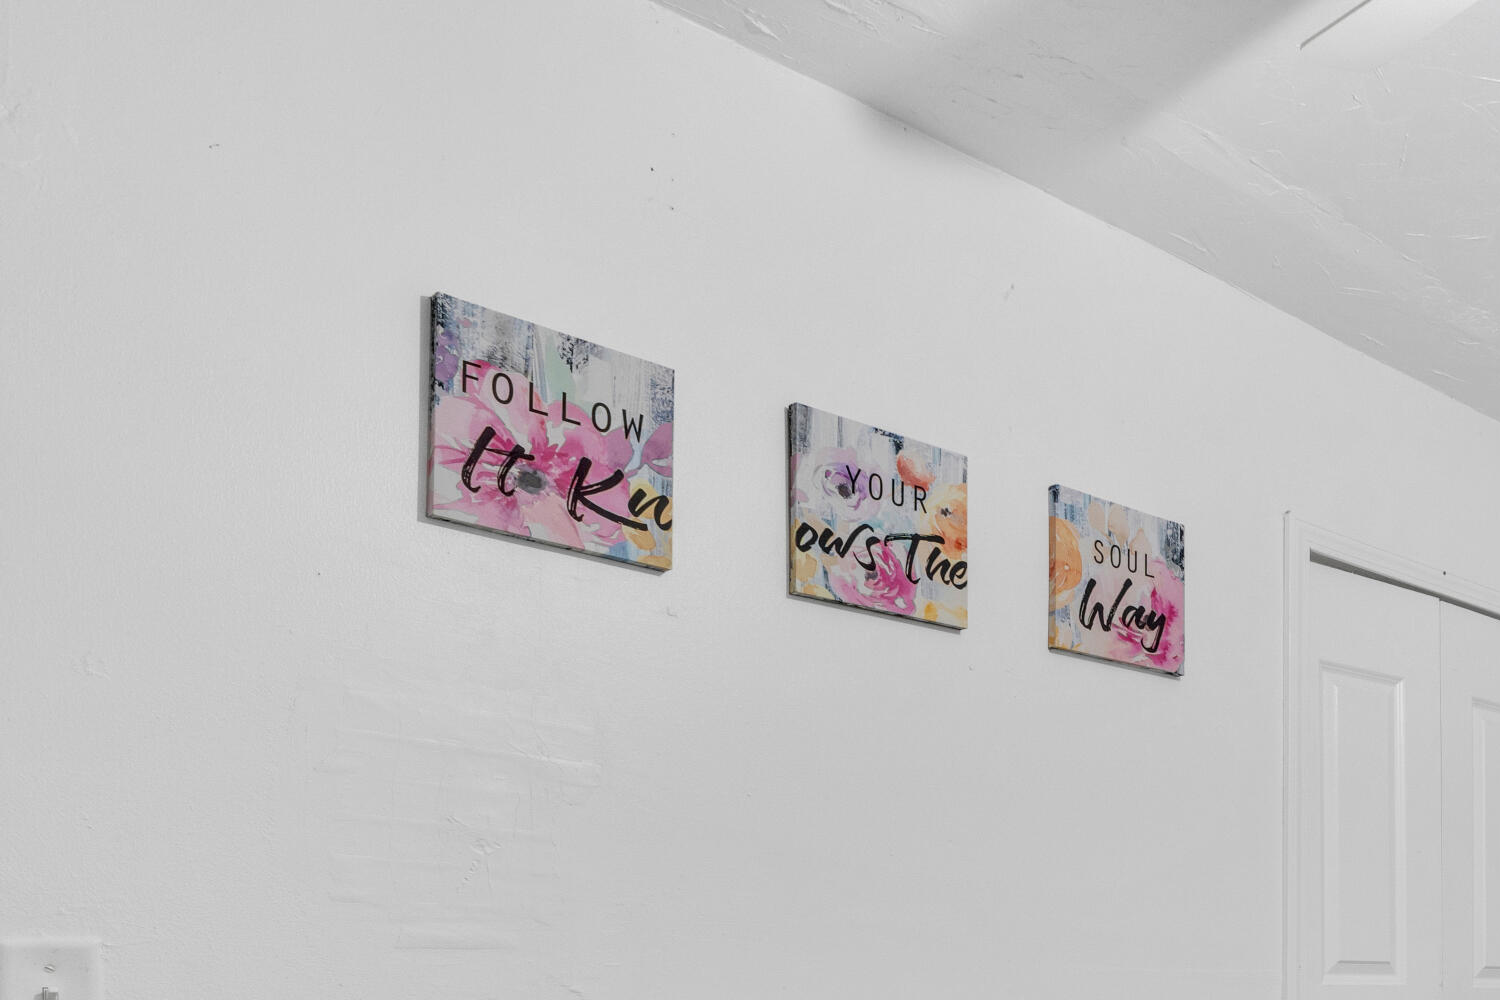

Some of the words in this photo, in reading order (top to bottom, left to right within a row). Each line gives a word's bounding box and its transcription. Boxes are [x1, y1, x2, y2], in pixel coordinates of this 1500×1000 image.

[462, 360, 643, 443] FOLLOW
[566, 457, 673, 531] Kn
[846, 464, 927, 514] YOUR
[884, 533, 968, 590] The
[1093, 539, 1155, 579] SOUL
[1079, 578, 1167, 653] Way
